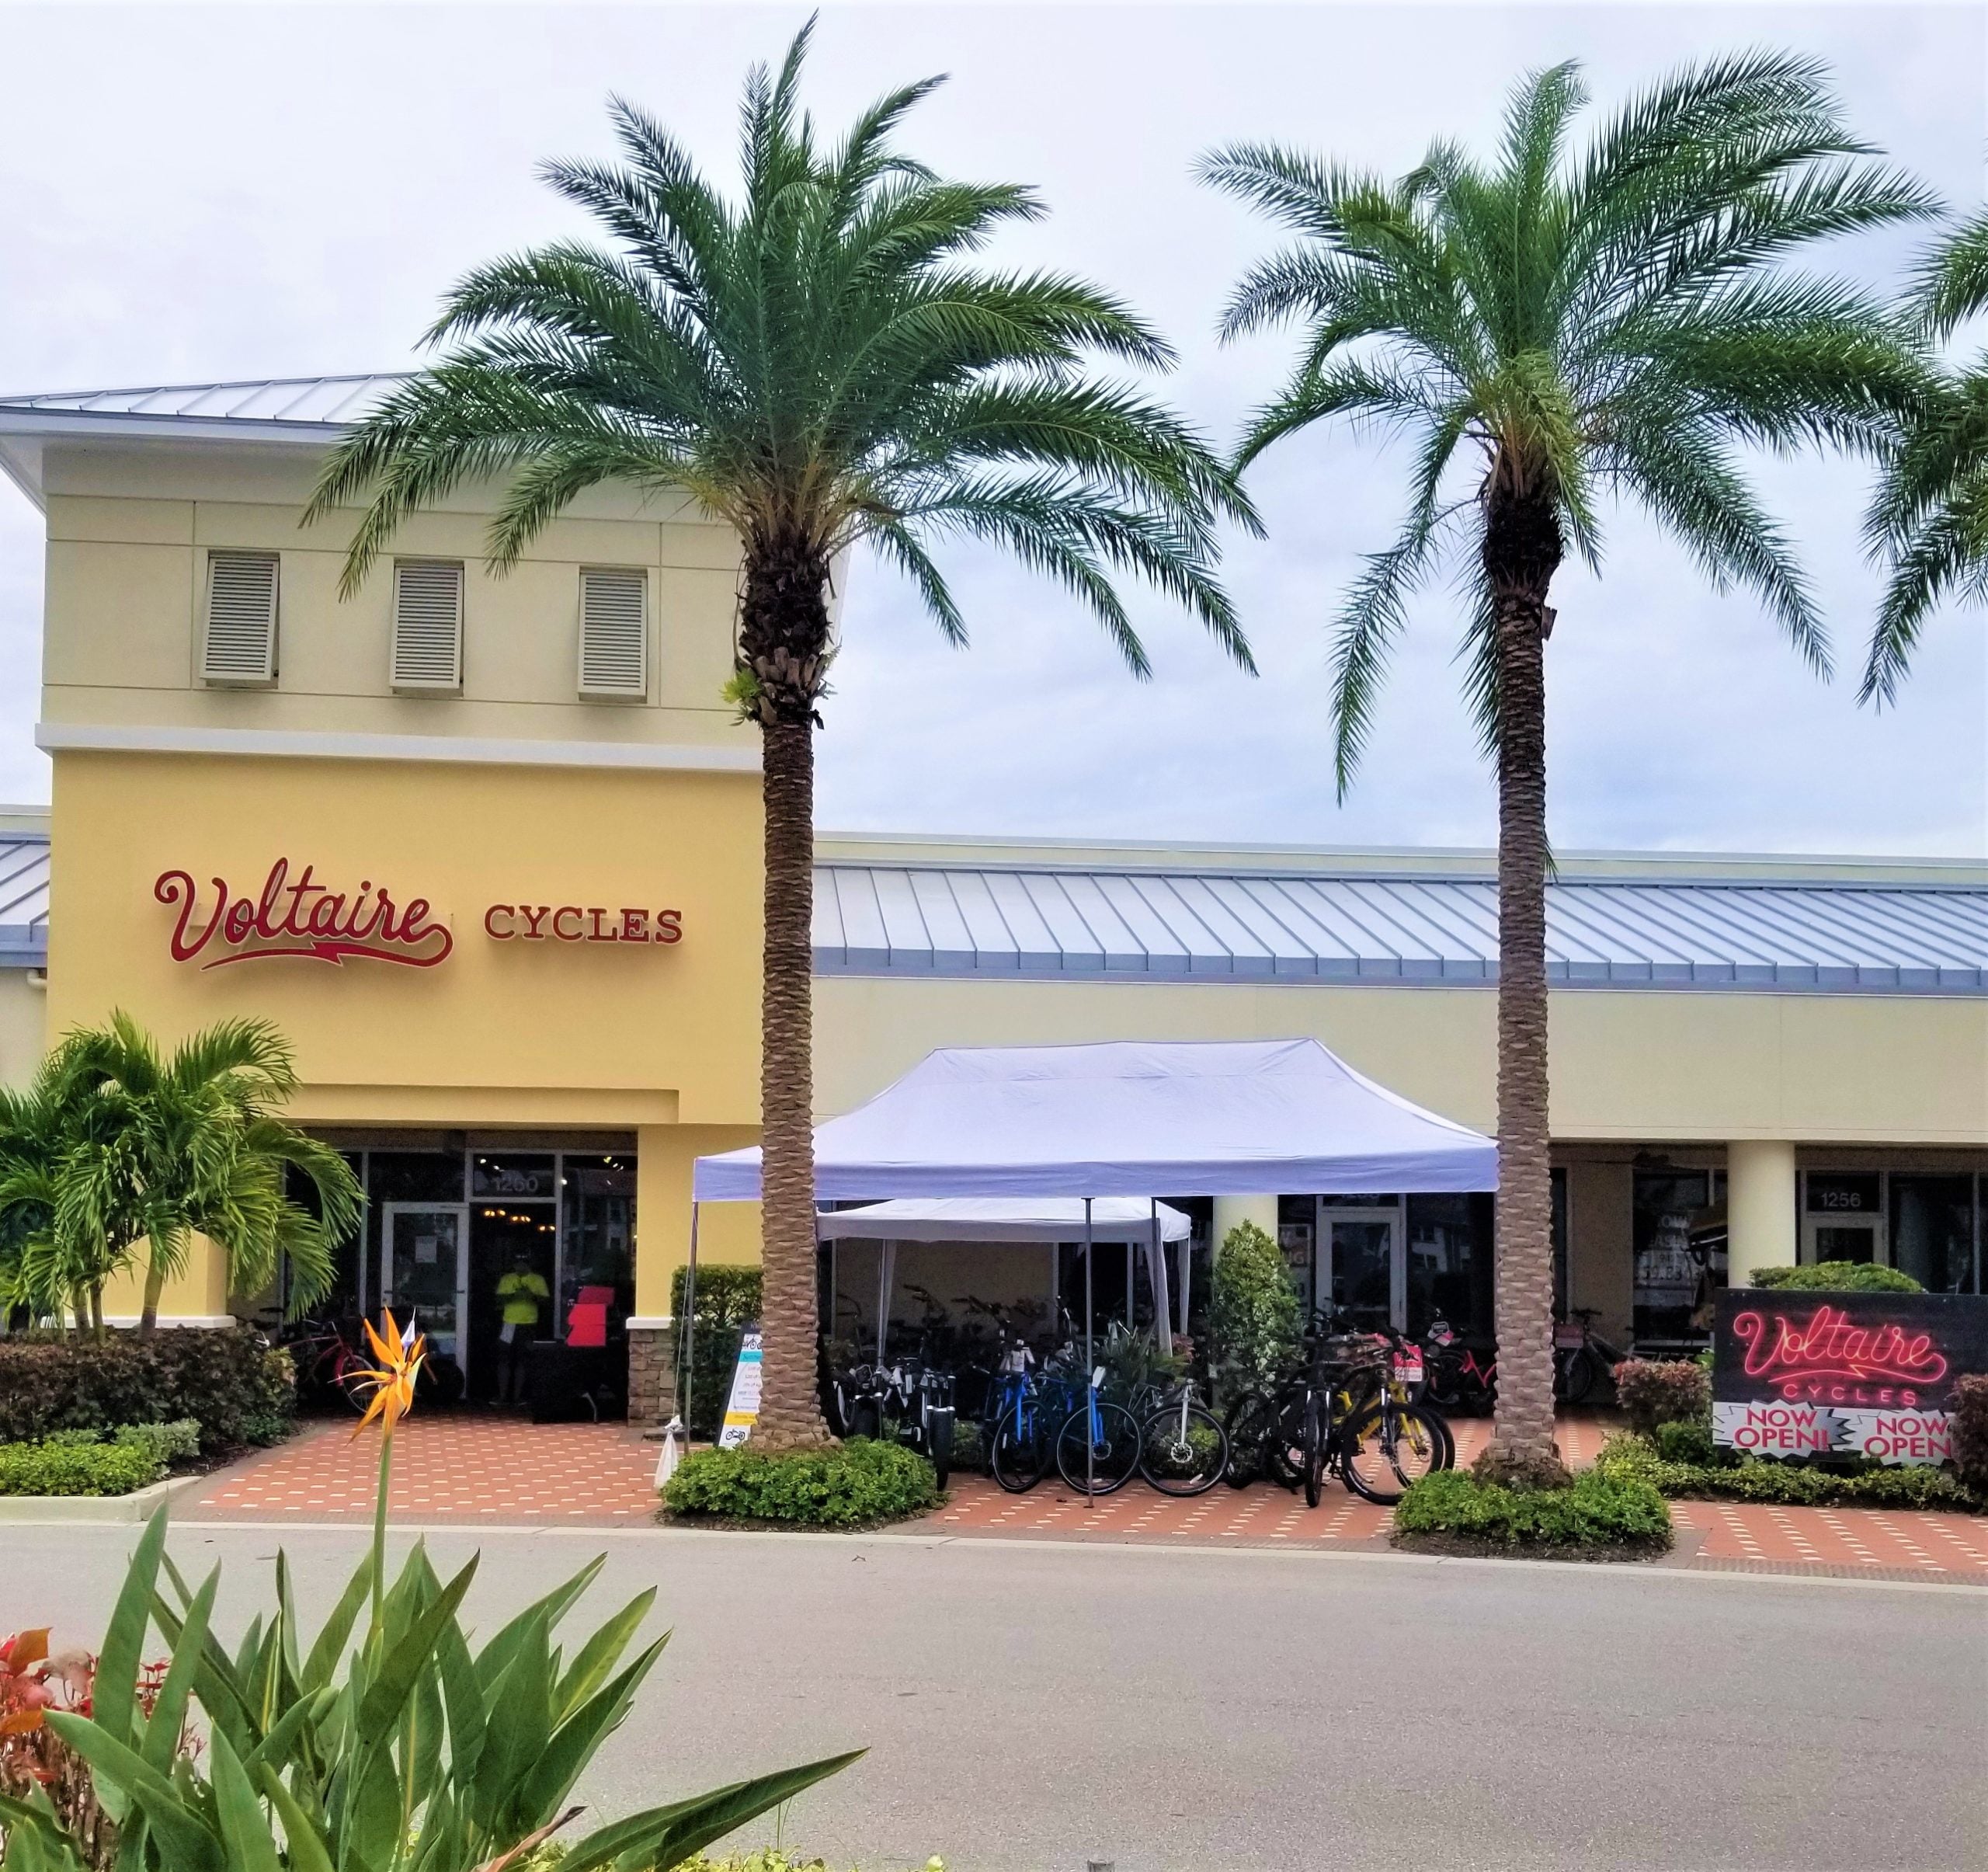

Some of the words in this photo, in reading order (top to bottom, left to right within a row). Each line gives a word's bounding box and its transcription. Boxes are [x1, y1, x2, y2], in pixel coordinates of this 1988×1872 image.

[155, 857, 454, 968] Voltaire
[483, 904, 683, 945] CYCLES
[492, 1175, 538, 1193] 1260
[1821, 1192, 1861, 1207] 1256
[1733, 1305, 1947, 1382] Voltaire
[1782, 1383, 1917, 1406] CYCLES
[1746, 1408, 1818, 1428] NOW
[1875, 1417, 1950, 1436] NOW
[1733, 1427, 1829, 1451] OPEN!
